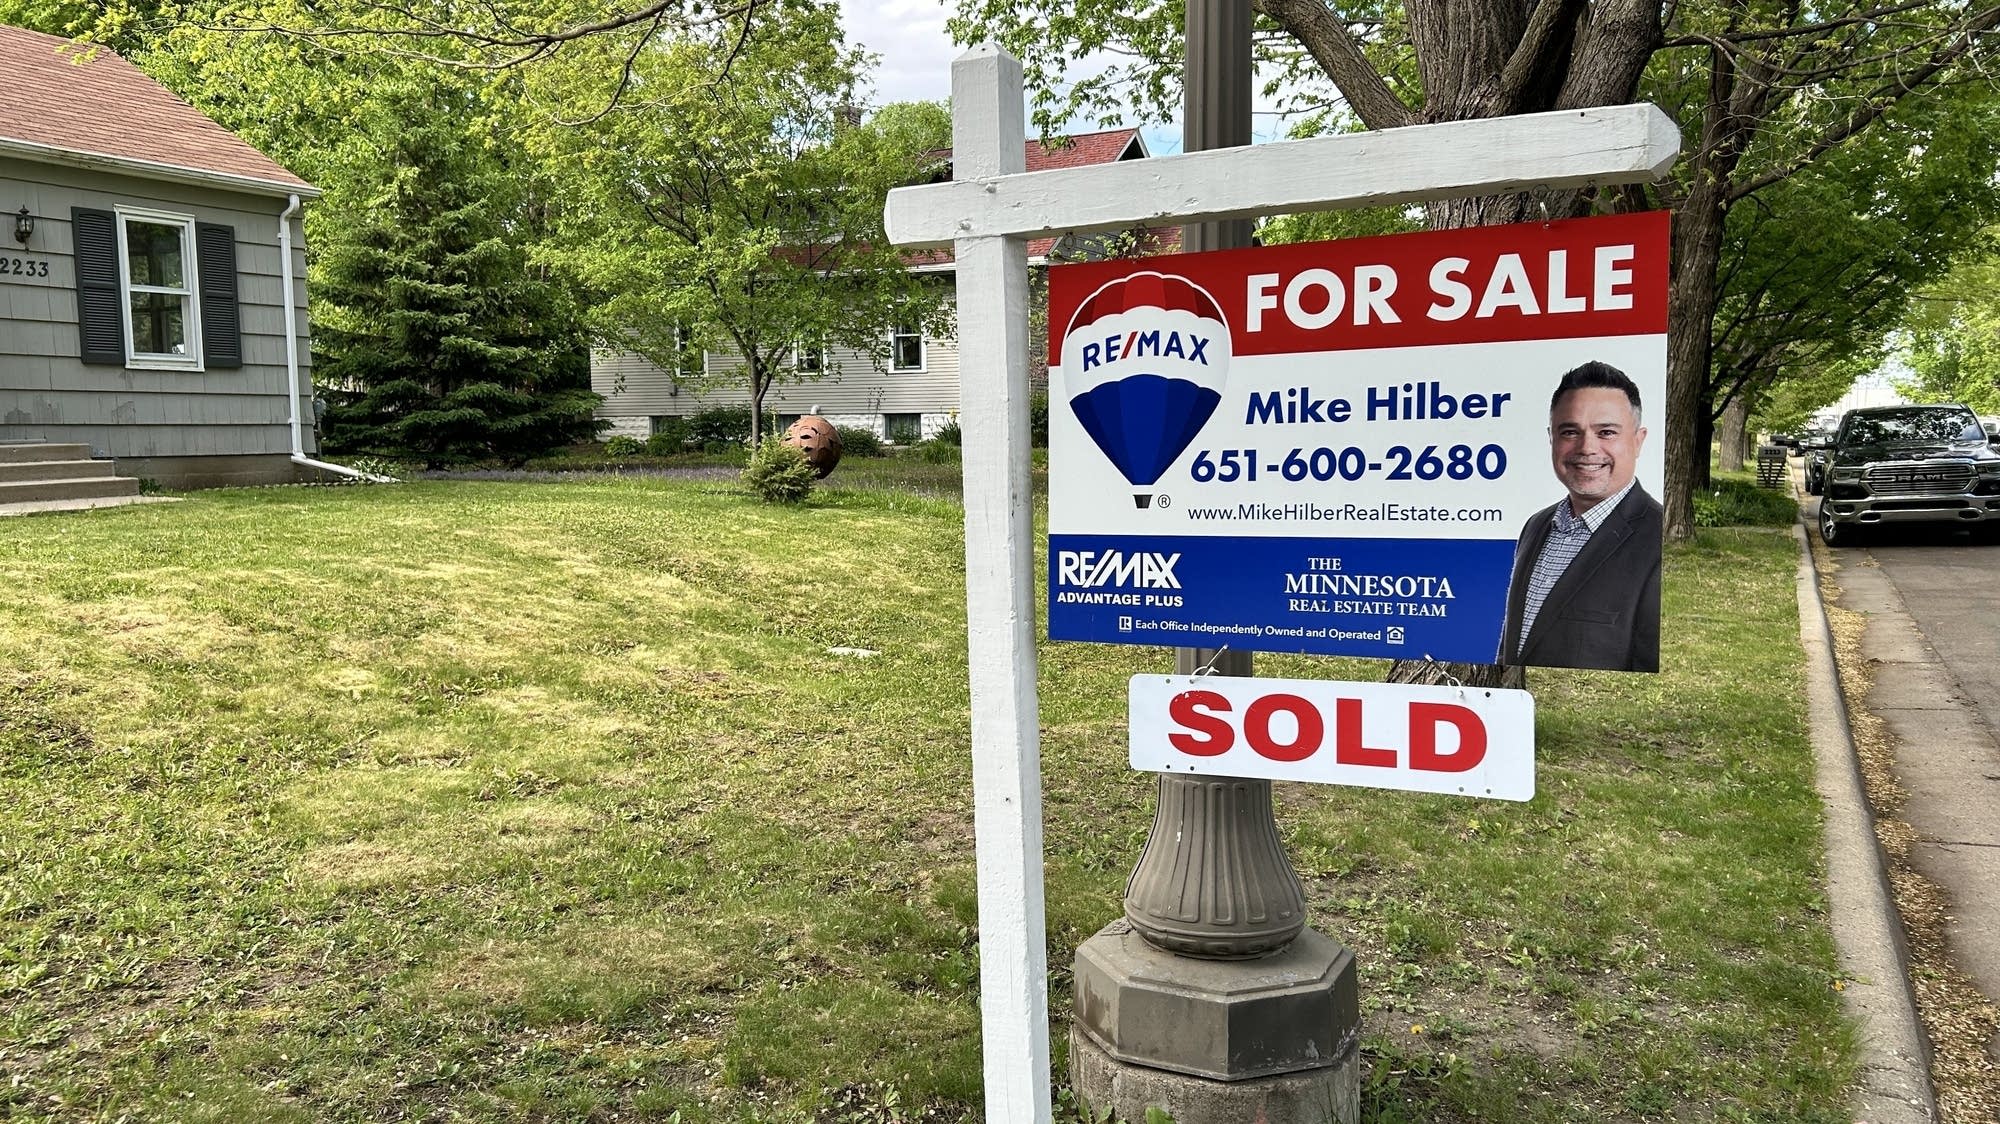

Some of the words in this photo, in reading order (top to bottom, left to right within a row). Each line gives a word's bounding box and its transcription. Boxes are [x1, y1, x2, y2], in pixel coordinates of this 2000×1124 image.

[0, 257, 49, 277] 2233
[1246, 264, 1402, 333] FOR
[1427, 244, 1635, 322] SALE
[1083, 330, 1210, 372] RE/MAX
[1245, 387, 1352, 425] Mike
[1366, 381, 1511, 421] Hilber
[1190, 444, 1507, 483] 651-600-2680
[1188, 503, 1503, 523] www.MikeHilberRealEstate.com
[1058, 549, 1182, 588] RE/MAX
[1308, 557, 1342, 571] THE
[1284, 573, 1456, 599] MINNESOTA
[1057, 592, 1141, 605] ADVANTAGE
[1145, 595, 1183, 607] PLUS
[1289, 599, 1331, 613] REAL
[1334, 600, 1393, 615] ESTATE
[1397, 602, 1447, 617] TEAM
[1135, 620, 1158, 630] Each
[1160, 621, 1189, 632] Office
[1191, 622, 1263, 637] Independently
[1265, 625, 1304, 637] Owned
[1305, 628, 1326, 638] and
[1328, 628, 1381, 641] Operated
[1168, 690, 1487, 772] SOLD
